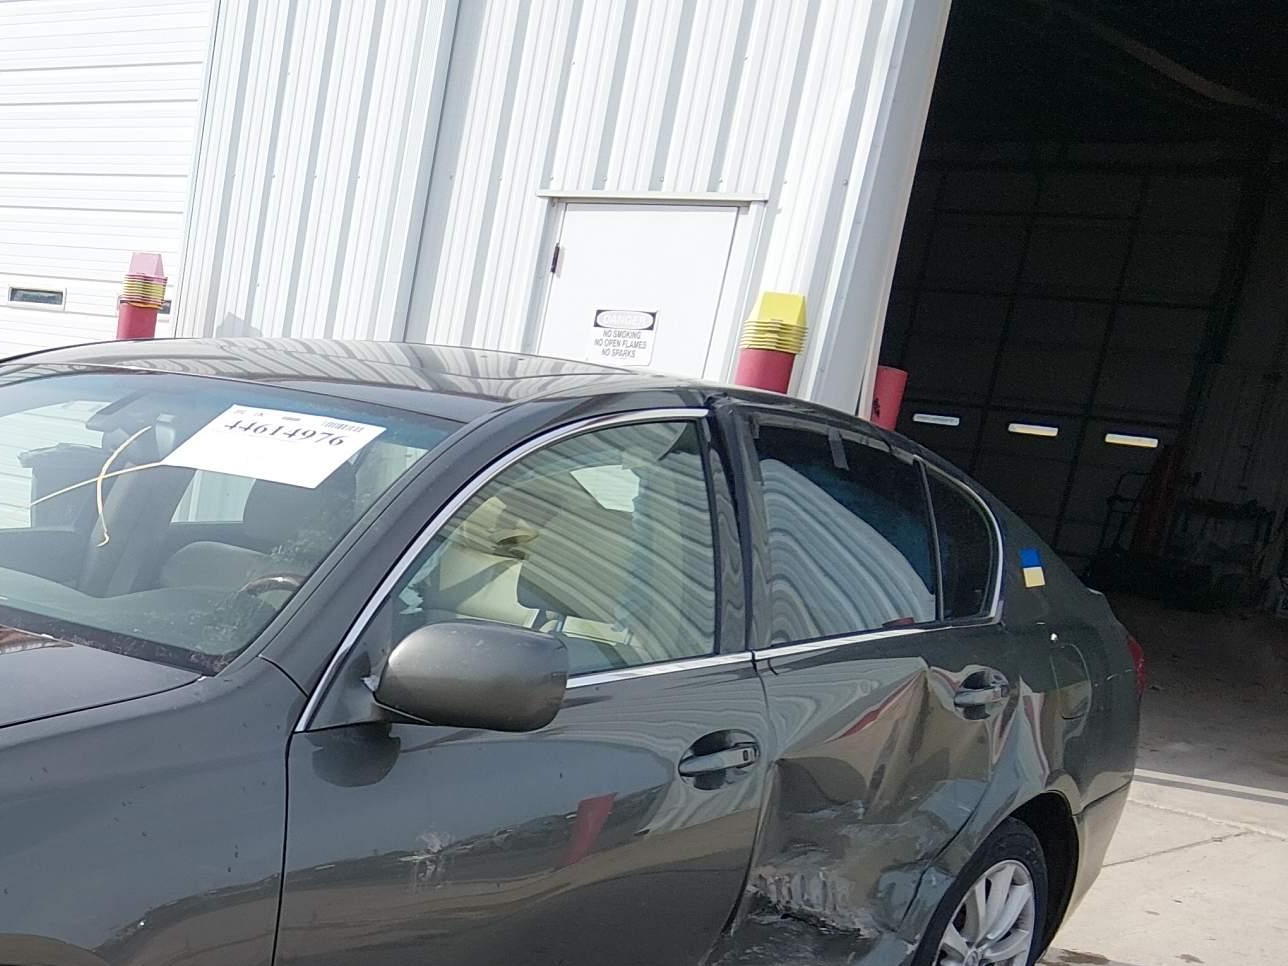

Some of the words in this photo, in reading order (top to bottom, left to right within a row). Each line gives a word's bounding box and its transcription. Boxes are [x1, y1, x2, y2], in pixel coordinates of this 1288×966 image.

[603, 329, 612, 338] NO
[613, 330, 641, 339] SMOKING
[594, 338, 603, 347] NO
[604, 338, 621, 348] OPEN
[622, 340, 647, 349] FLAMES
[602, 348, 611, 357] NO
[612, 349, 636, 358] SPARKS
[224, 420, 345, 446] 44614976
